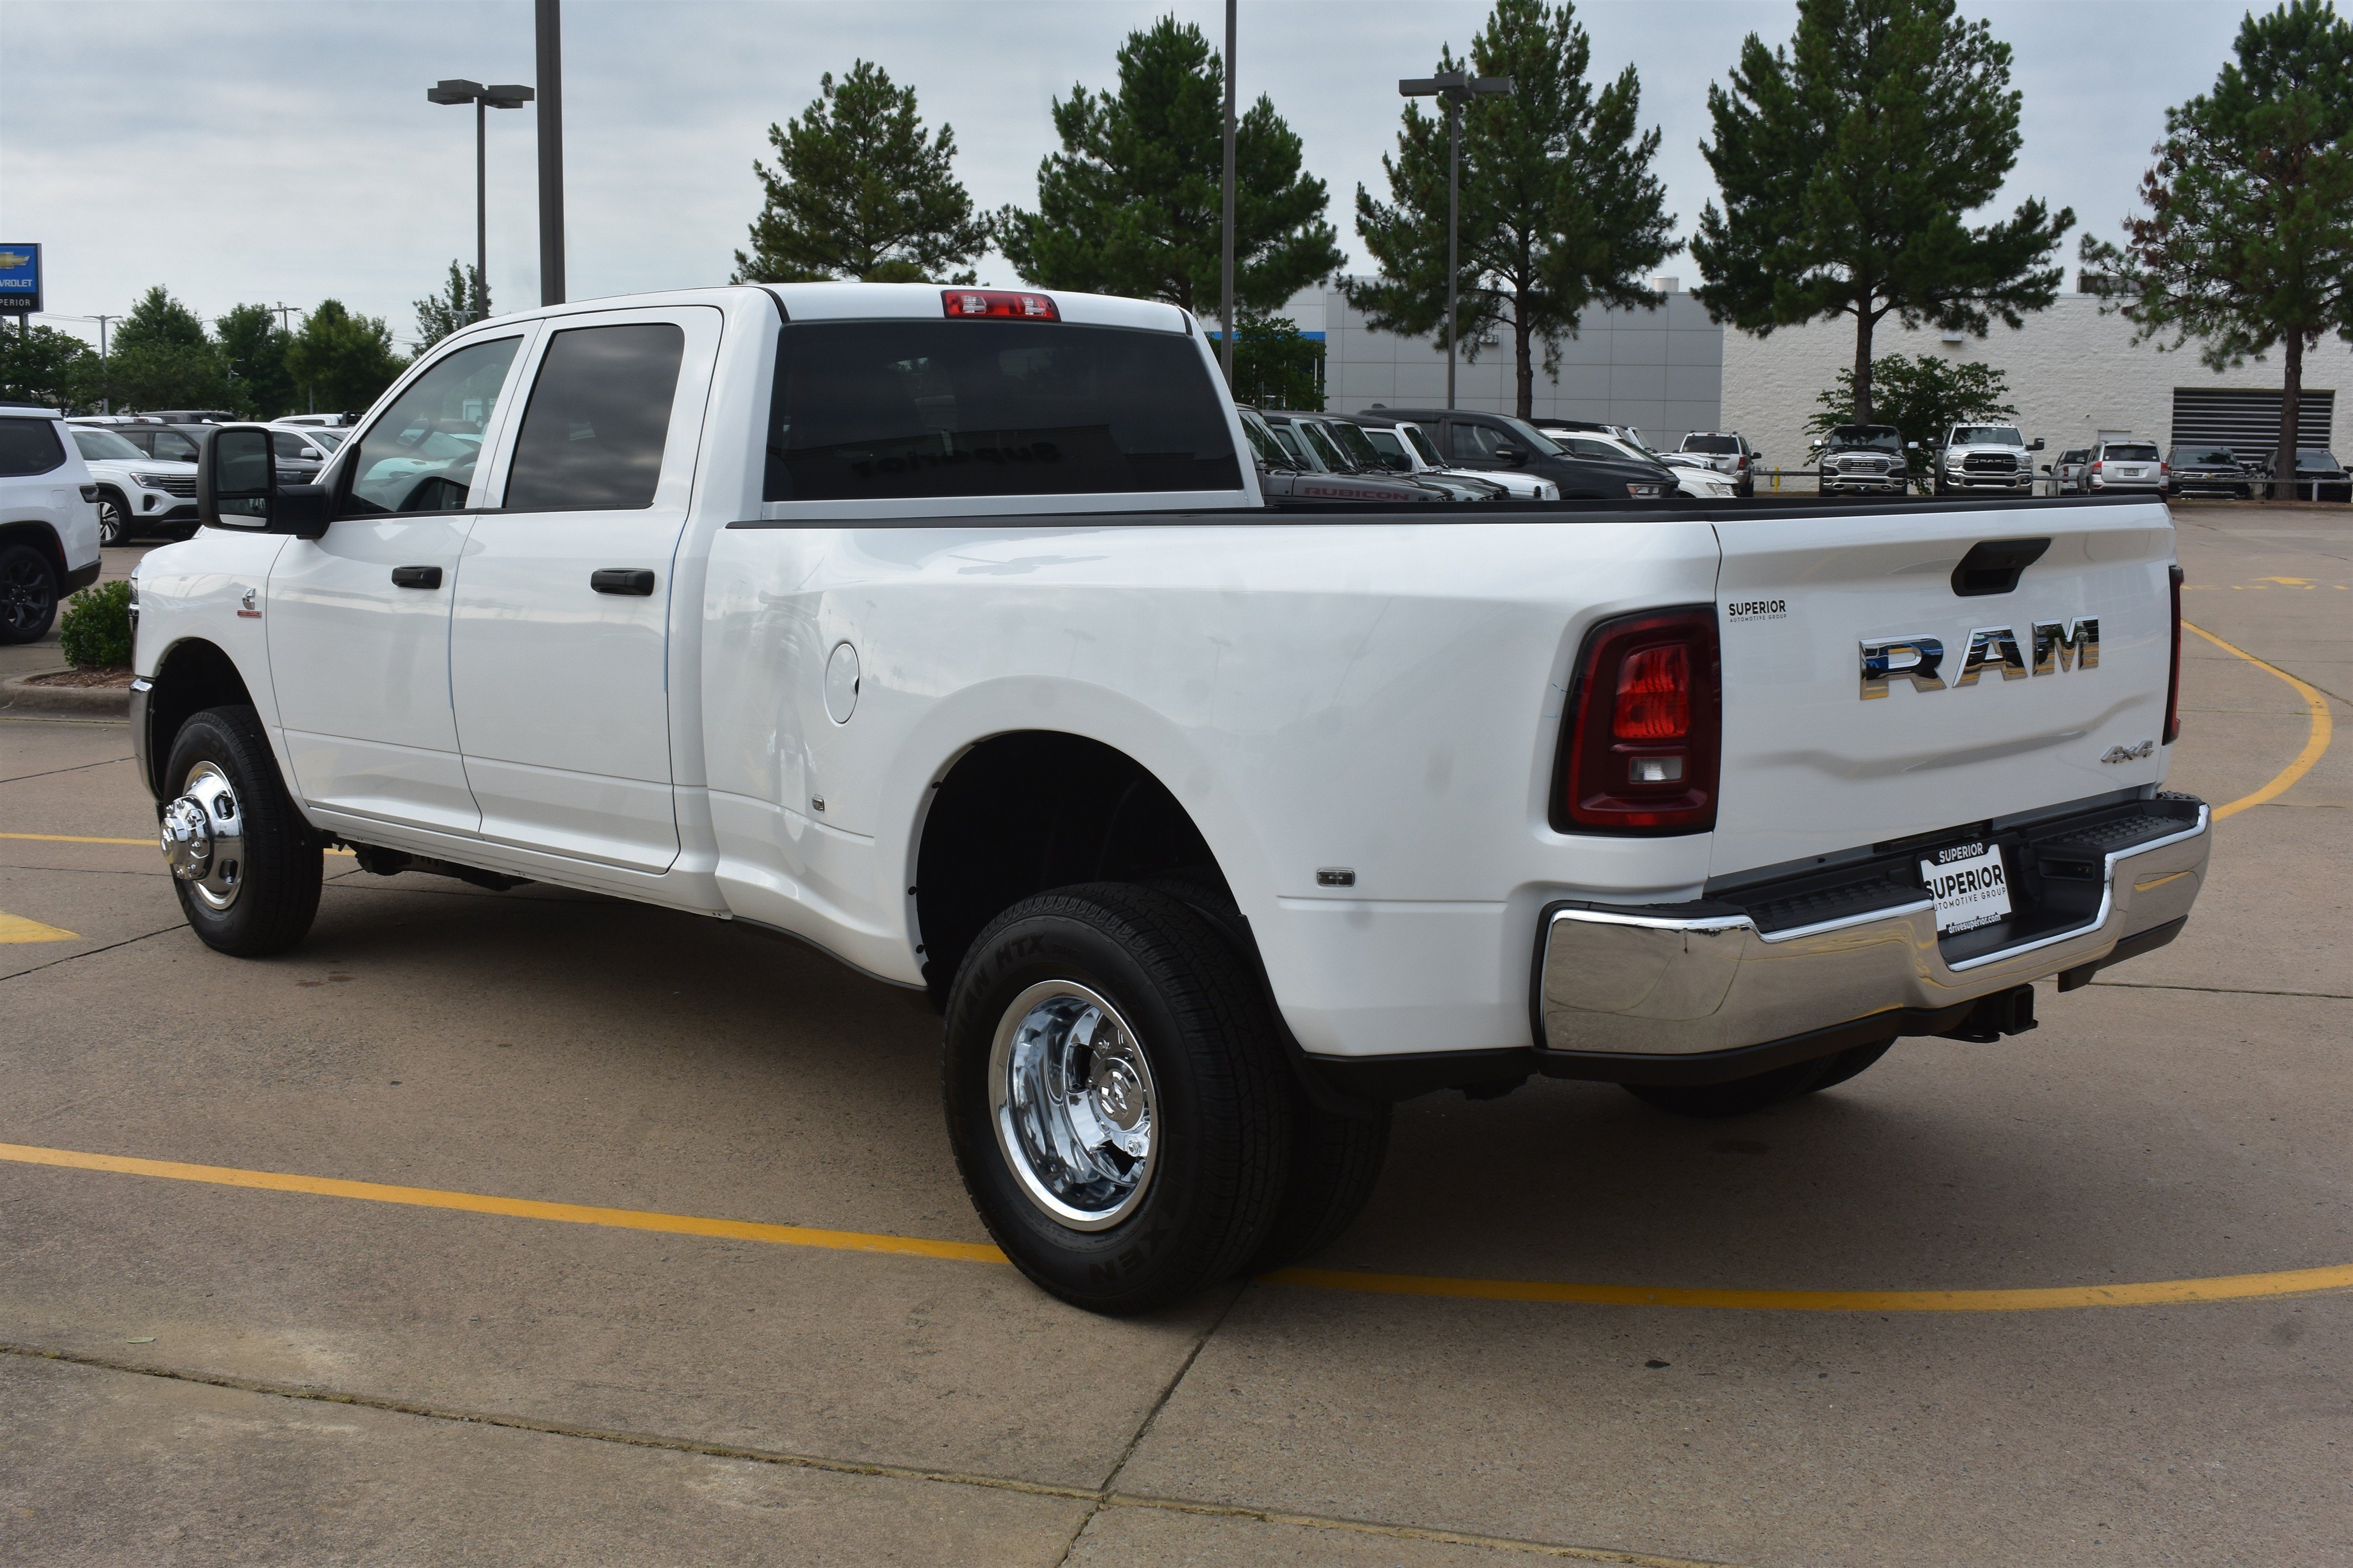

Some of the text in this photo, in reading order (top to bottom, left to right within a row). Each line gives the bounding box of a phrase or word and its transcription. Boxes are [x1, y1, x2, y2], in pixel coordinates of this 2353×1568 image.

[1303, 487, 1410, 501] RUBICON
[1729, 600, 1787, 616] SUPERIOR
[1859, 614, 2099, 701] RAM
[1939, 842, 1984, 863] SUPERIOR
[1924, 864, 2005, 901] SUPERIOR
[1934, 887, 2007, 912] UTOMOTIVE GROUP
[1948, 914, 2001, 934] drivesuperior.com
[994, 931, 1048, 971] HTX
